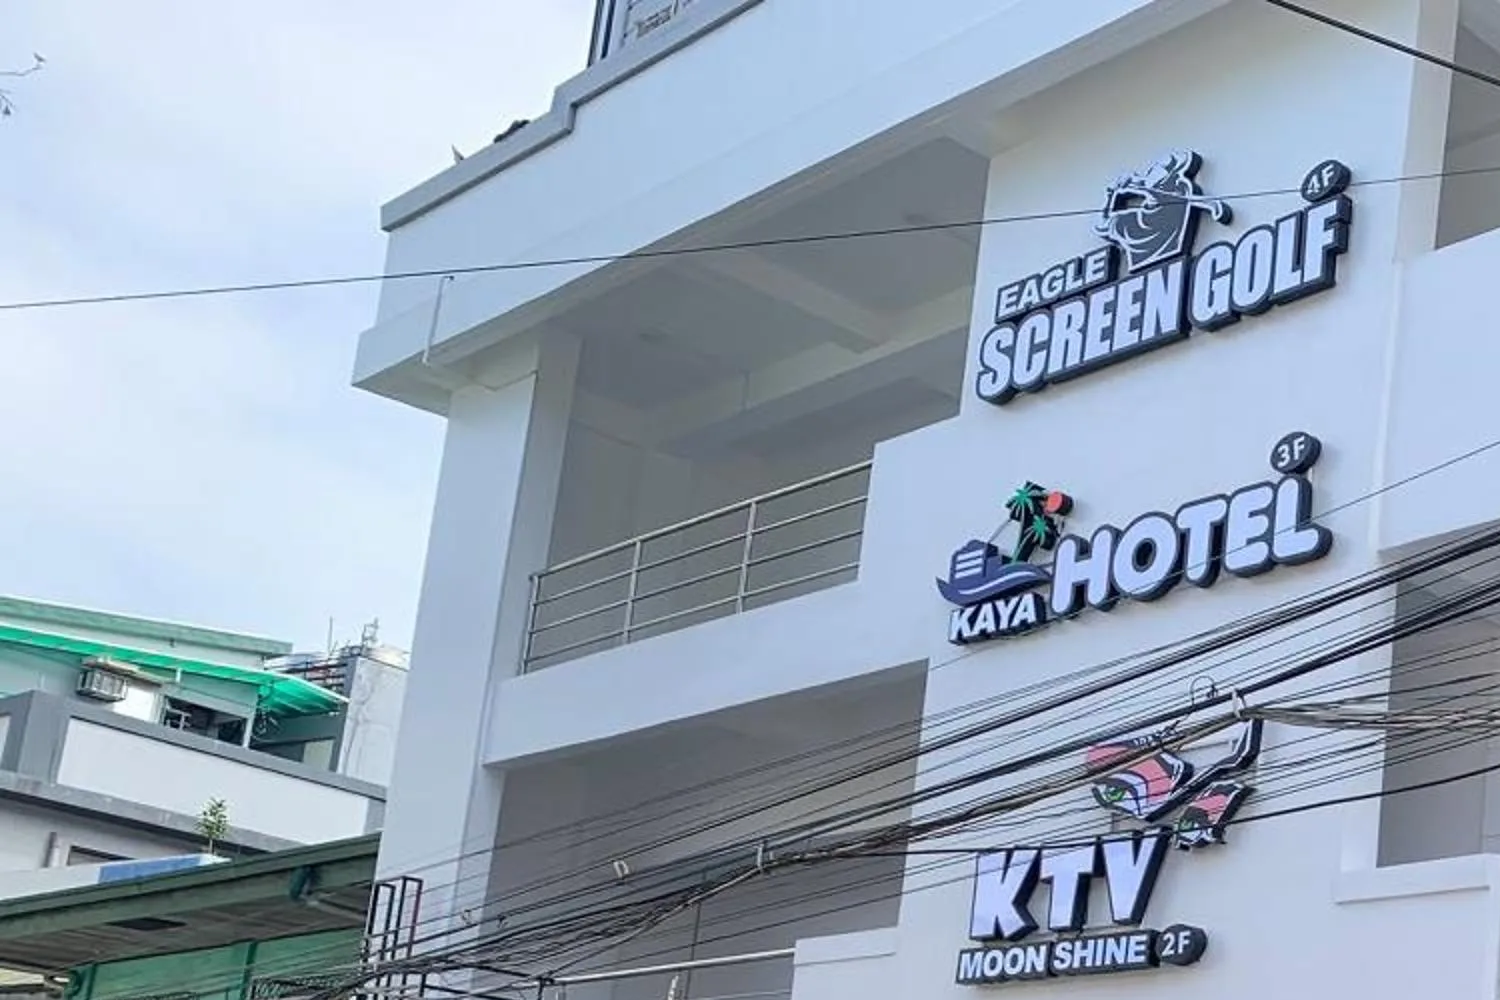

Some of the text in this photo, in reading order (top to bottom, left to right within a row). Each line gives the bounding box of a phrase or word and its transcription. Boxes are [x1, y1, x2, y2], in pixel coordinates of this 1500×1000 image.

[1307, 165, 1336, 196] 4F
[978, 200, 1342, 399] SCREEN GOLF
[999, 254, 1106, 313] EAGLE
[1277, 435, 1306, 468] 3F
[949, 477, 1320, 640] KAYA HOTEL
[970, 831, 1160, 941] KTV
[958, 933, 1191, 981] MOON SHINE 2F
